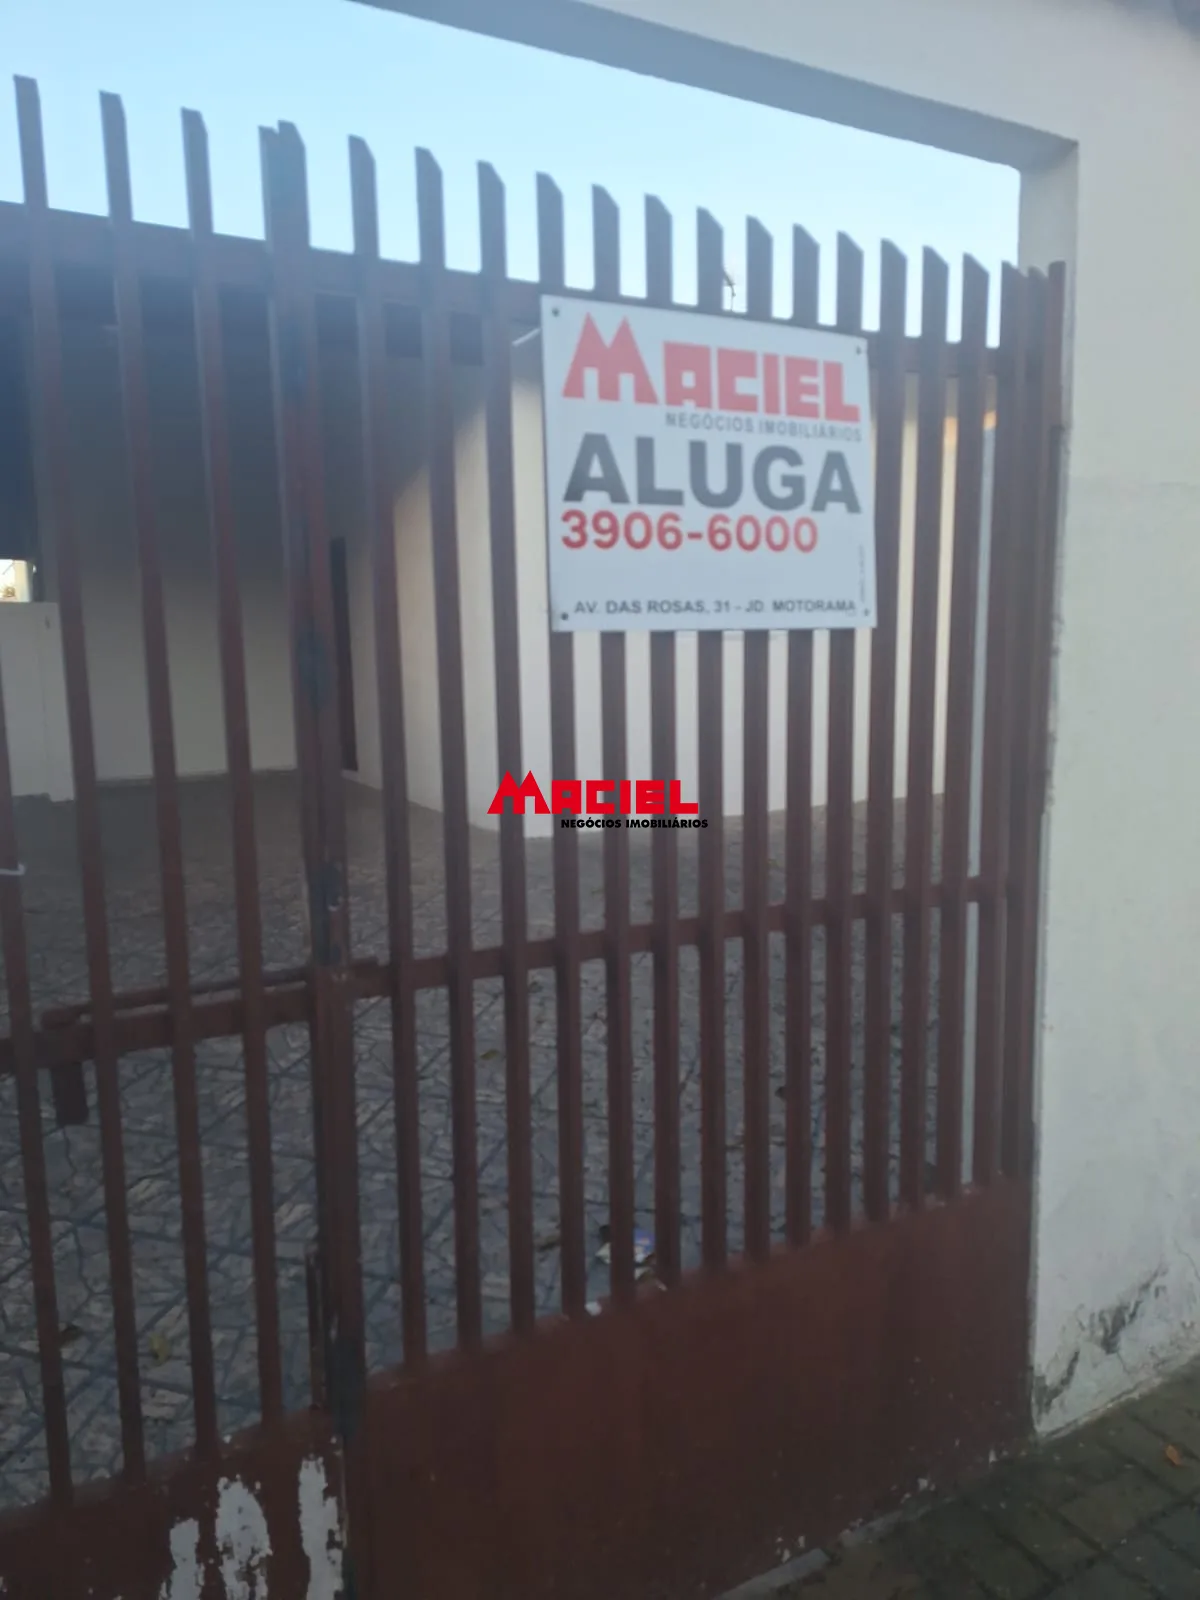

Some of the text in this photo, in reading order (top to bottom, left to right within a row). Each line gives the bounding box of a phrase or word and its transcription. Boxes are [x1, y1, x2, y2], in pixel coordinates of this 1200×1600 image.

[562, 311, 861, 423] MACIEL
[665, 411, 863, 444] NEGÓCIOS IMOBILIÁRIOS
[562, 432, 863, 514] ALUGA
[561, 509, 818, 553] 3906-6000
[606, 600, 642, 615] DAS
[713, 601, 731, 613] 31
[772, 601, 857, 613] MOTORAMA
